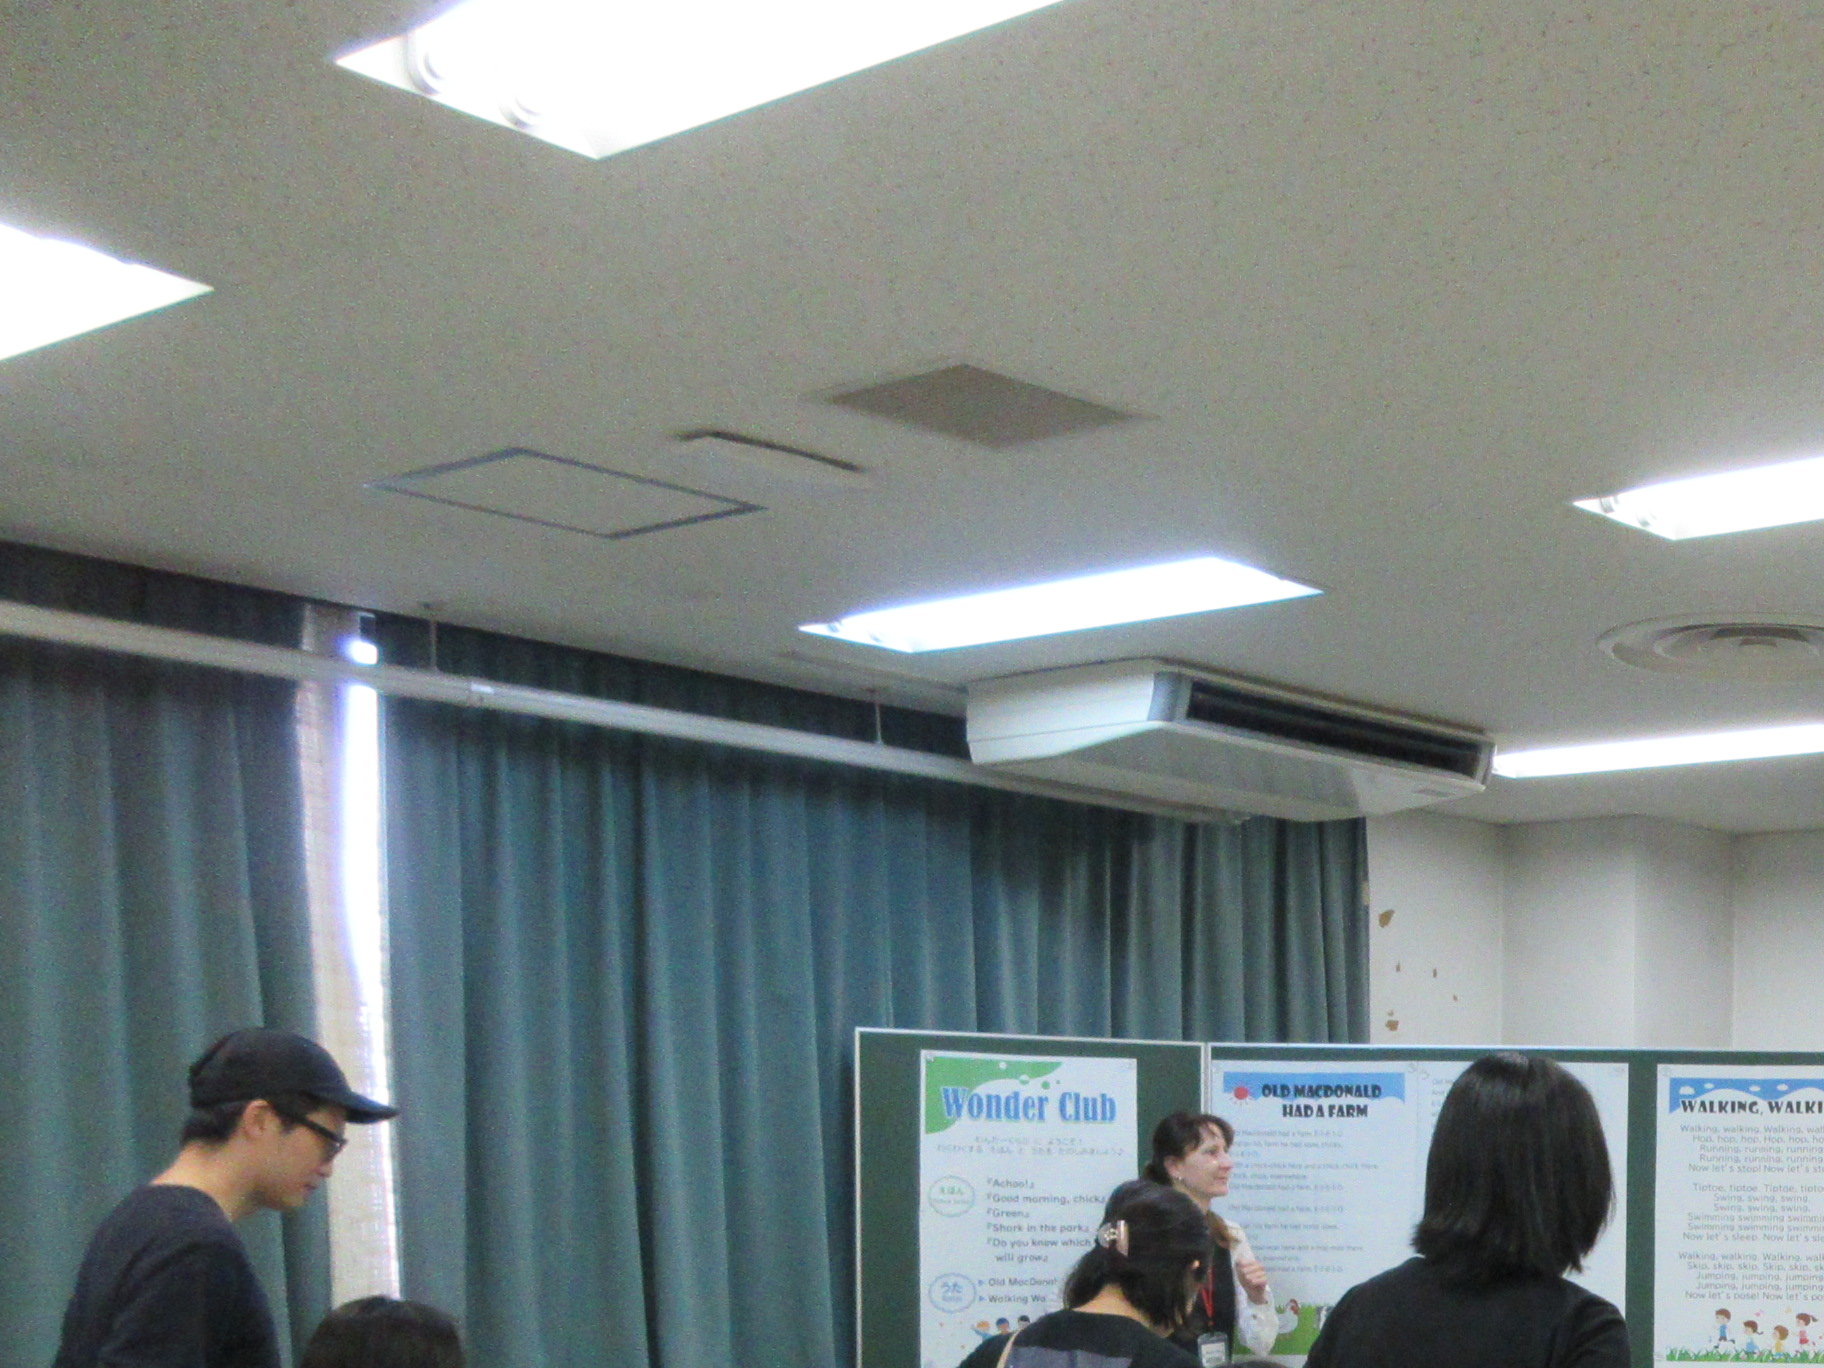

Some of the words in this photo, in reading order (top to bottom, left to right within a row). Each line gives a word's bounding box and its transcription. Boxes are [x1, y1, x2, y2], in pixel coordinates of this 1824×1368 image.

[1261, 1083, 1291, 1098] OLD
[1293, 1083, 1382, 1098] MACDONALD
[943, 1087, 1049, 1122] Wonder
[1059, 1091, 1117, 1124] Club
[1681, 1100, 1764, 1116] WALKING,
[1282, 1104, 1314, 1118] HAD
[1315, 1104, 1325, 1118] A
[1327, 1104, 1369, 1118] FARM
[1689, 1163, 1709, 1173] Now
[1764, 1163, 1784, 1173] Now
[1027, 1223, 1036, 1232] in
[1039, 1223, 1057, 1232] the
[1683, 1232, 1703, 1241] Now
[1763, 1233, 1784, 1242] Now
[1010, 1239, 1029, 1249] you
[1031, 1238, 1058, 1247] know
[995, 1253, 1014, 1262] will
[988, 1277, 1006, 1287] Old
[1685, 1290, 1705, 1299] Now
[1763, 1291, 1783, 1300] Now
